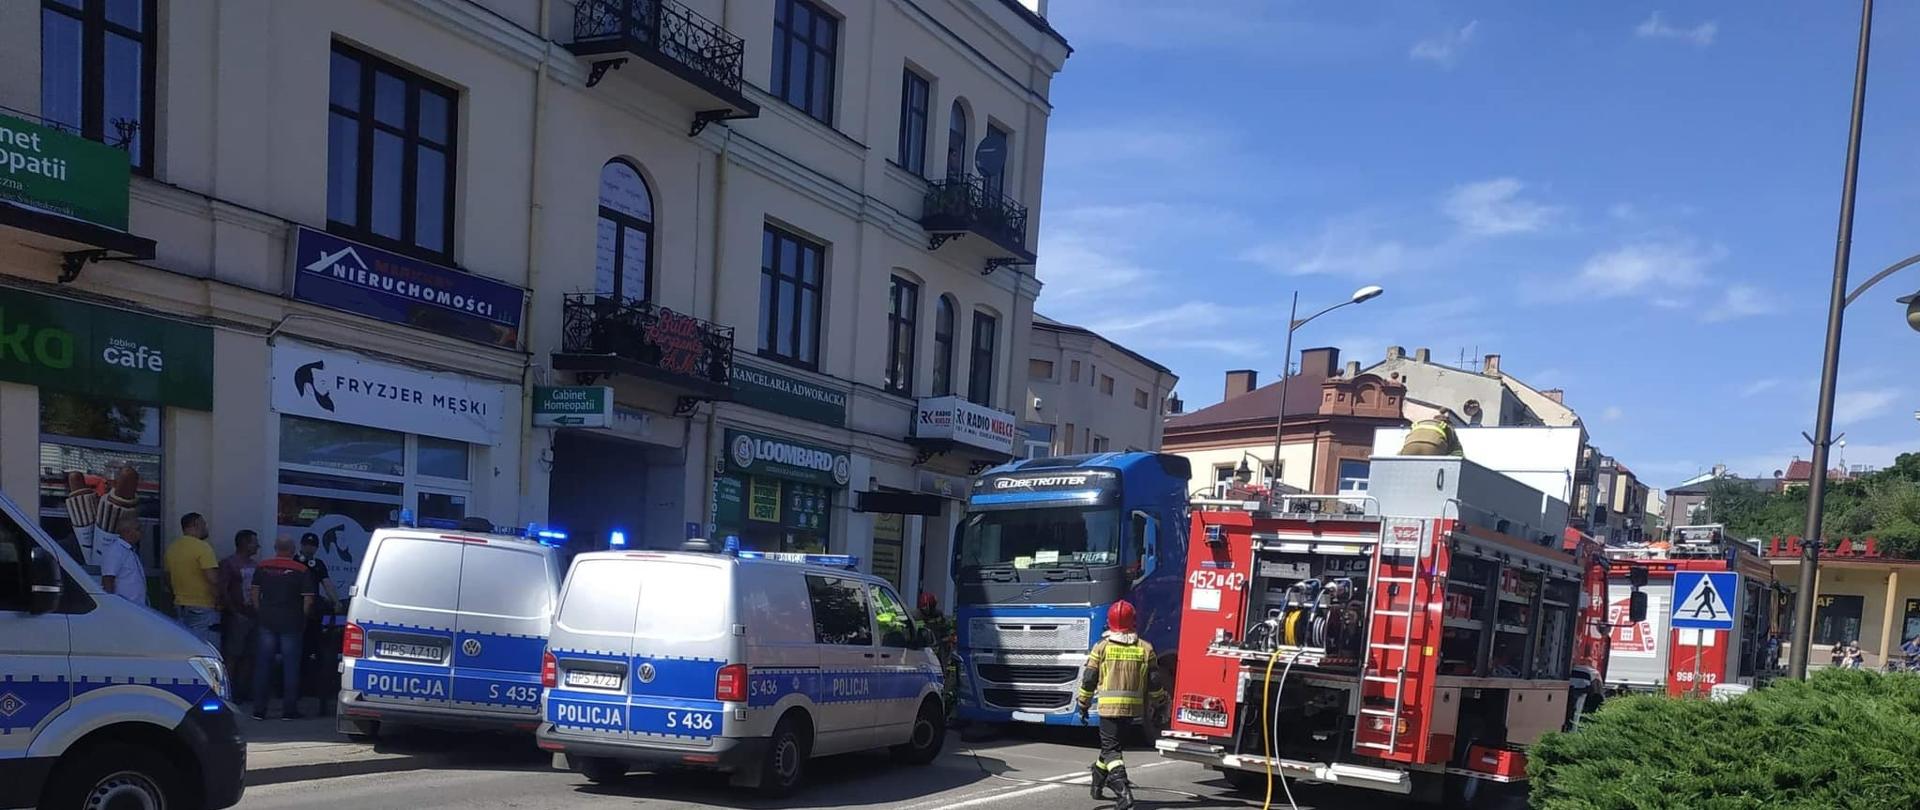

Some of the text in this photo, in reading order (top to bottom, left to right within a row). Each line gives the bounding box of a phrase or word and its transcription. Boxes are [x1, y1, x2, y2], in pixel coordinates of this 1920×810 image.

[333, 263, 492, 315] NIERUCHOMOŚCI
[336, 376, 487, 416] FRYZJER MĘSKI
[552, 389, 586, 401] Gabinet
[733, 367, 845, 407] KANCELARIA ADWOKACKA
[544, 400, 595, 412] Homeopatii
[967, 412, 990, 431] RADIO
[991, 418, 1013, 438] KIELCE
[754, 439, 833, 472] LOOMBARD
[997, 476, 1087, 489] GLOBETROTTER
[367, 673, 444, 697] POLICJA
[489, 684, 537, 702] S 435
[751, 679, 777, 696] S 436
[833, 678, 869, 697] POLICJA
[558, 703, 622, 726] POLICJA
[667, 711, 713, 730] S 436
